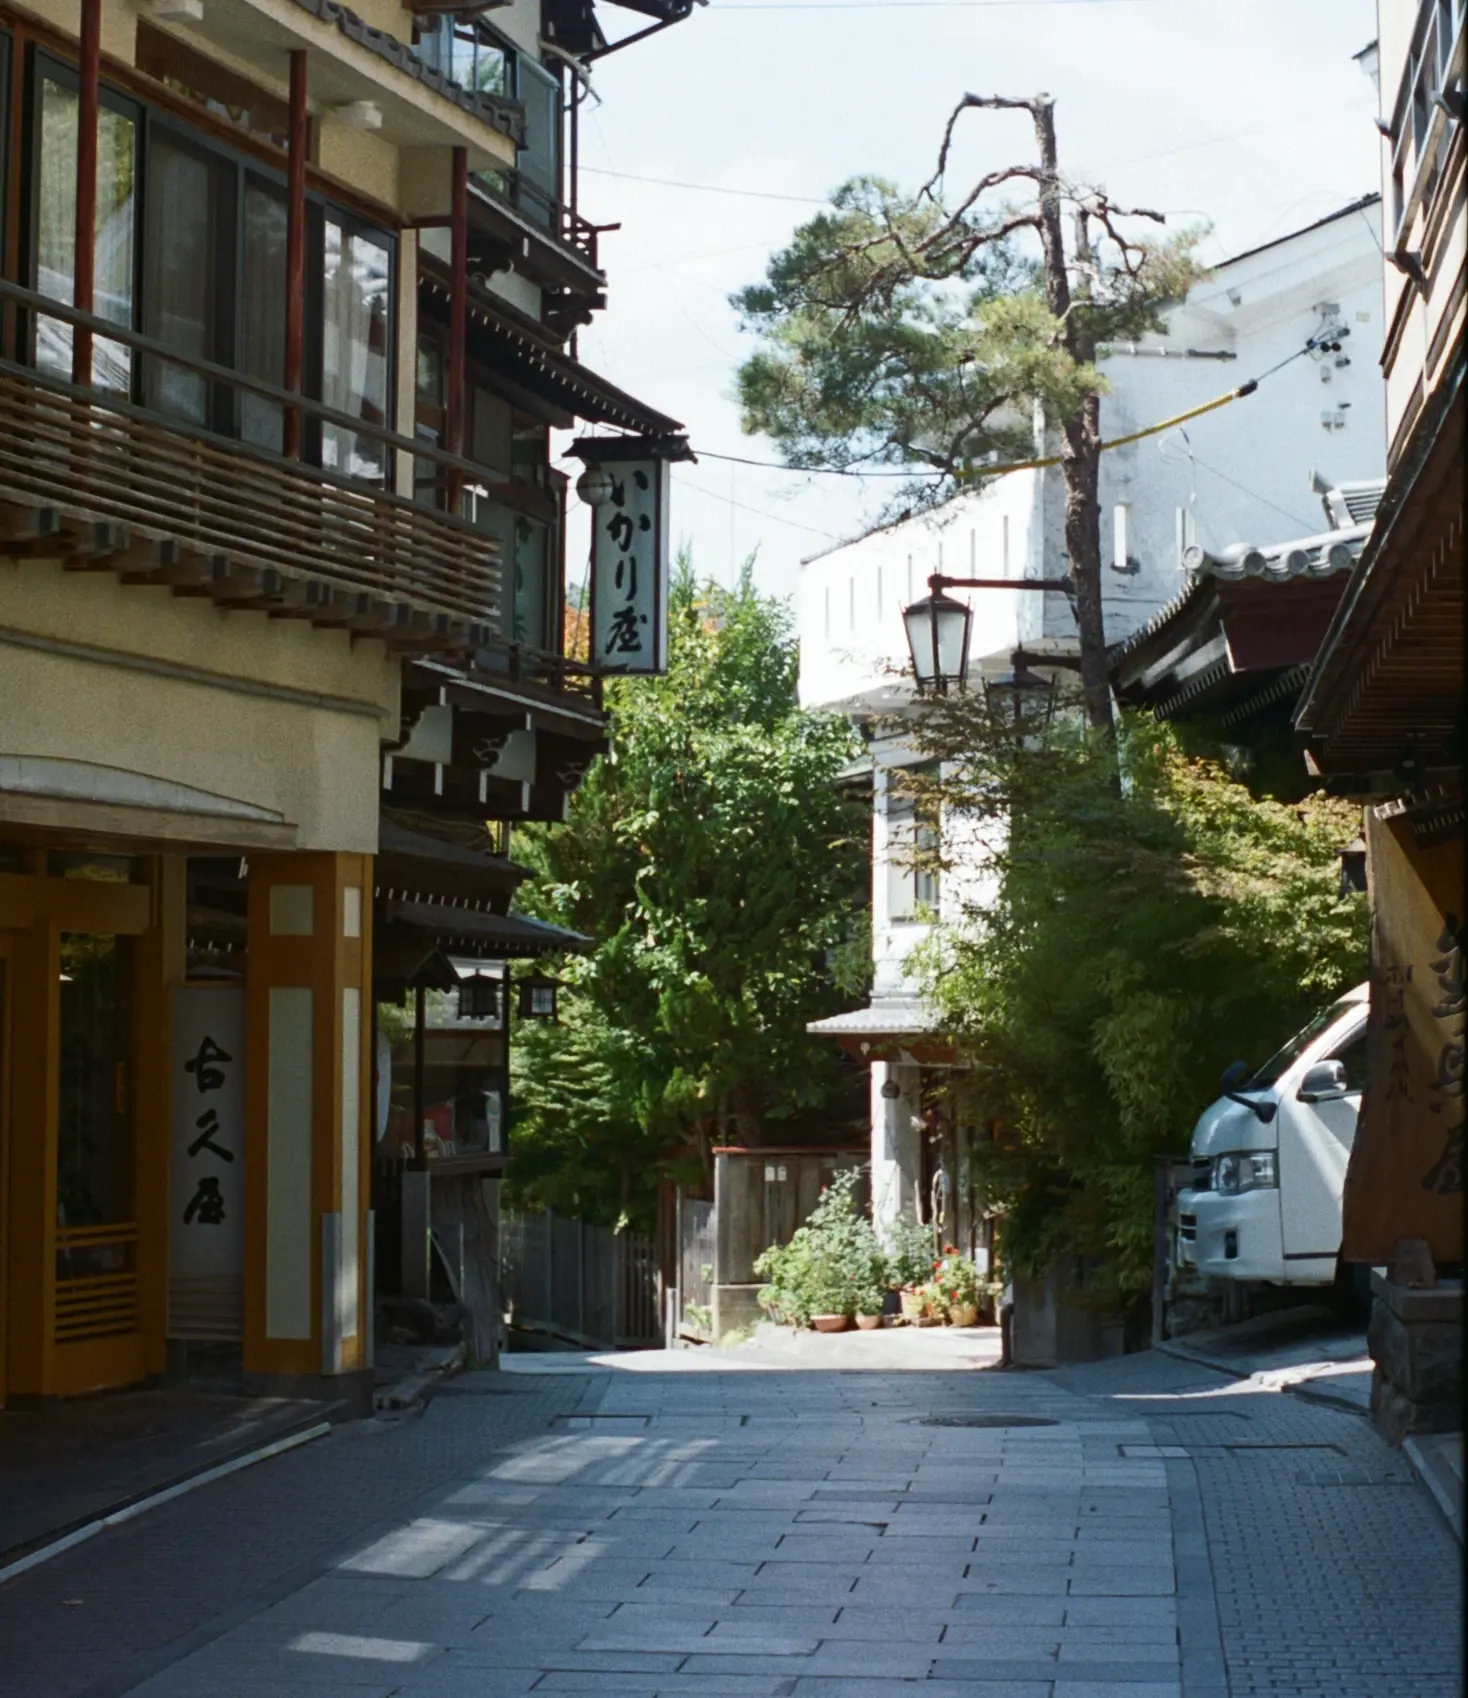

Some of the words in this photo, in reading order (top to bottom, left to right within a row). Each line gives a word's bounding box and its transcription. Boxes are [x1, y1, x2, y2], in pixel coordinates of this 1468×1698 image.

[605, 470, 652, 655] いかり屋
[182, 1035, 236, 1226] 古久屋
